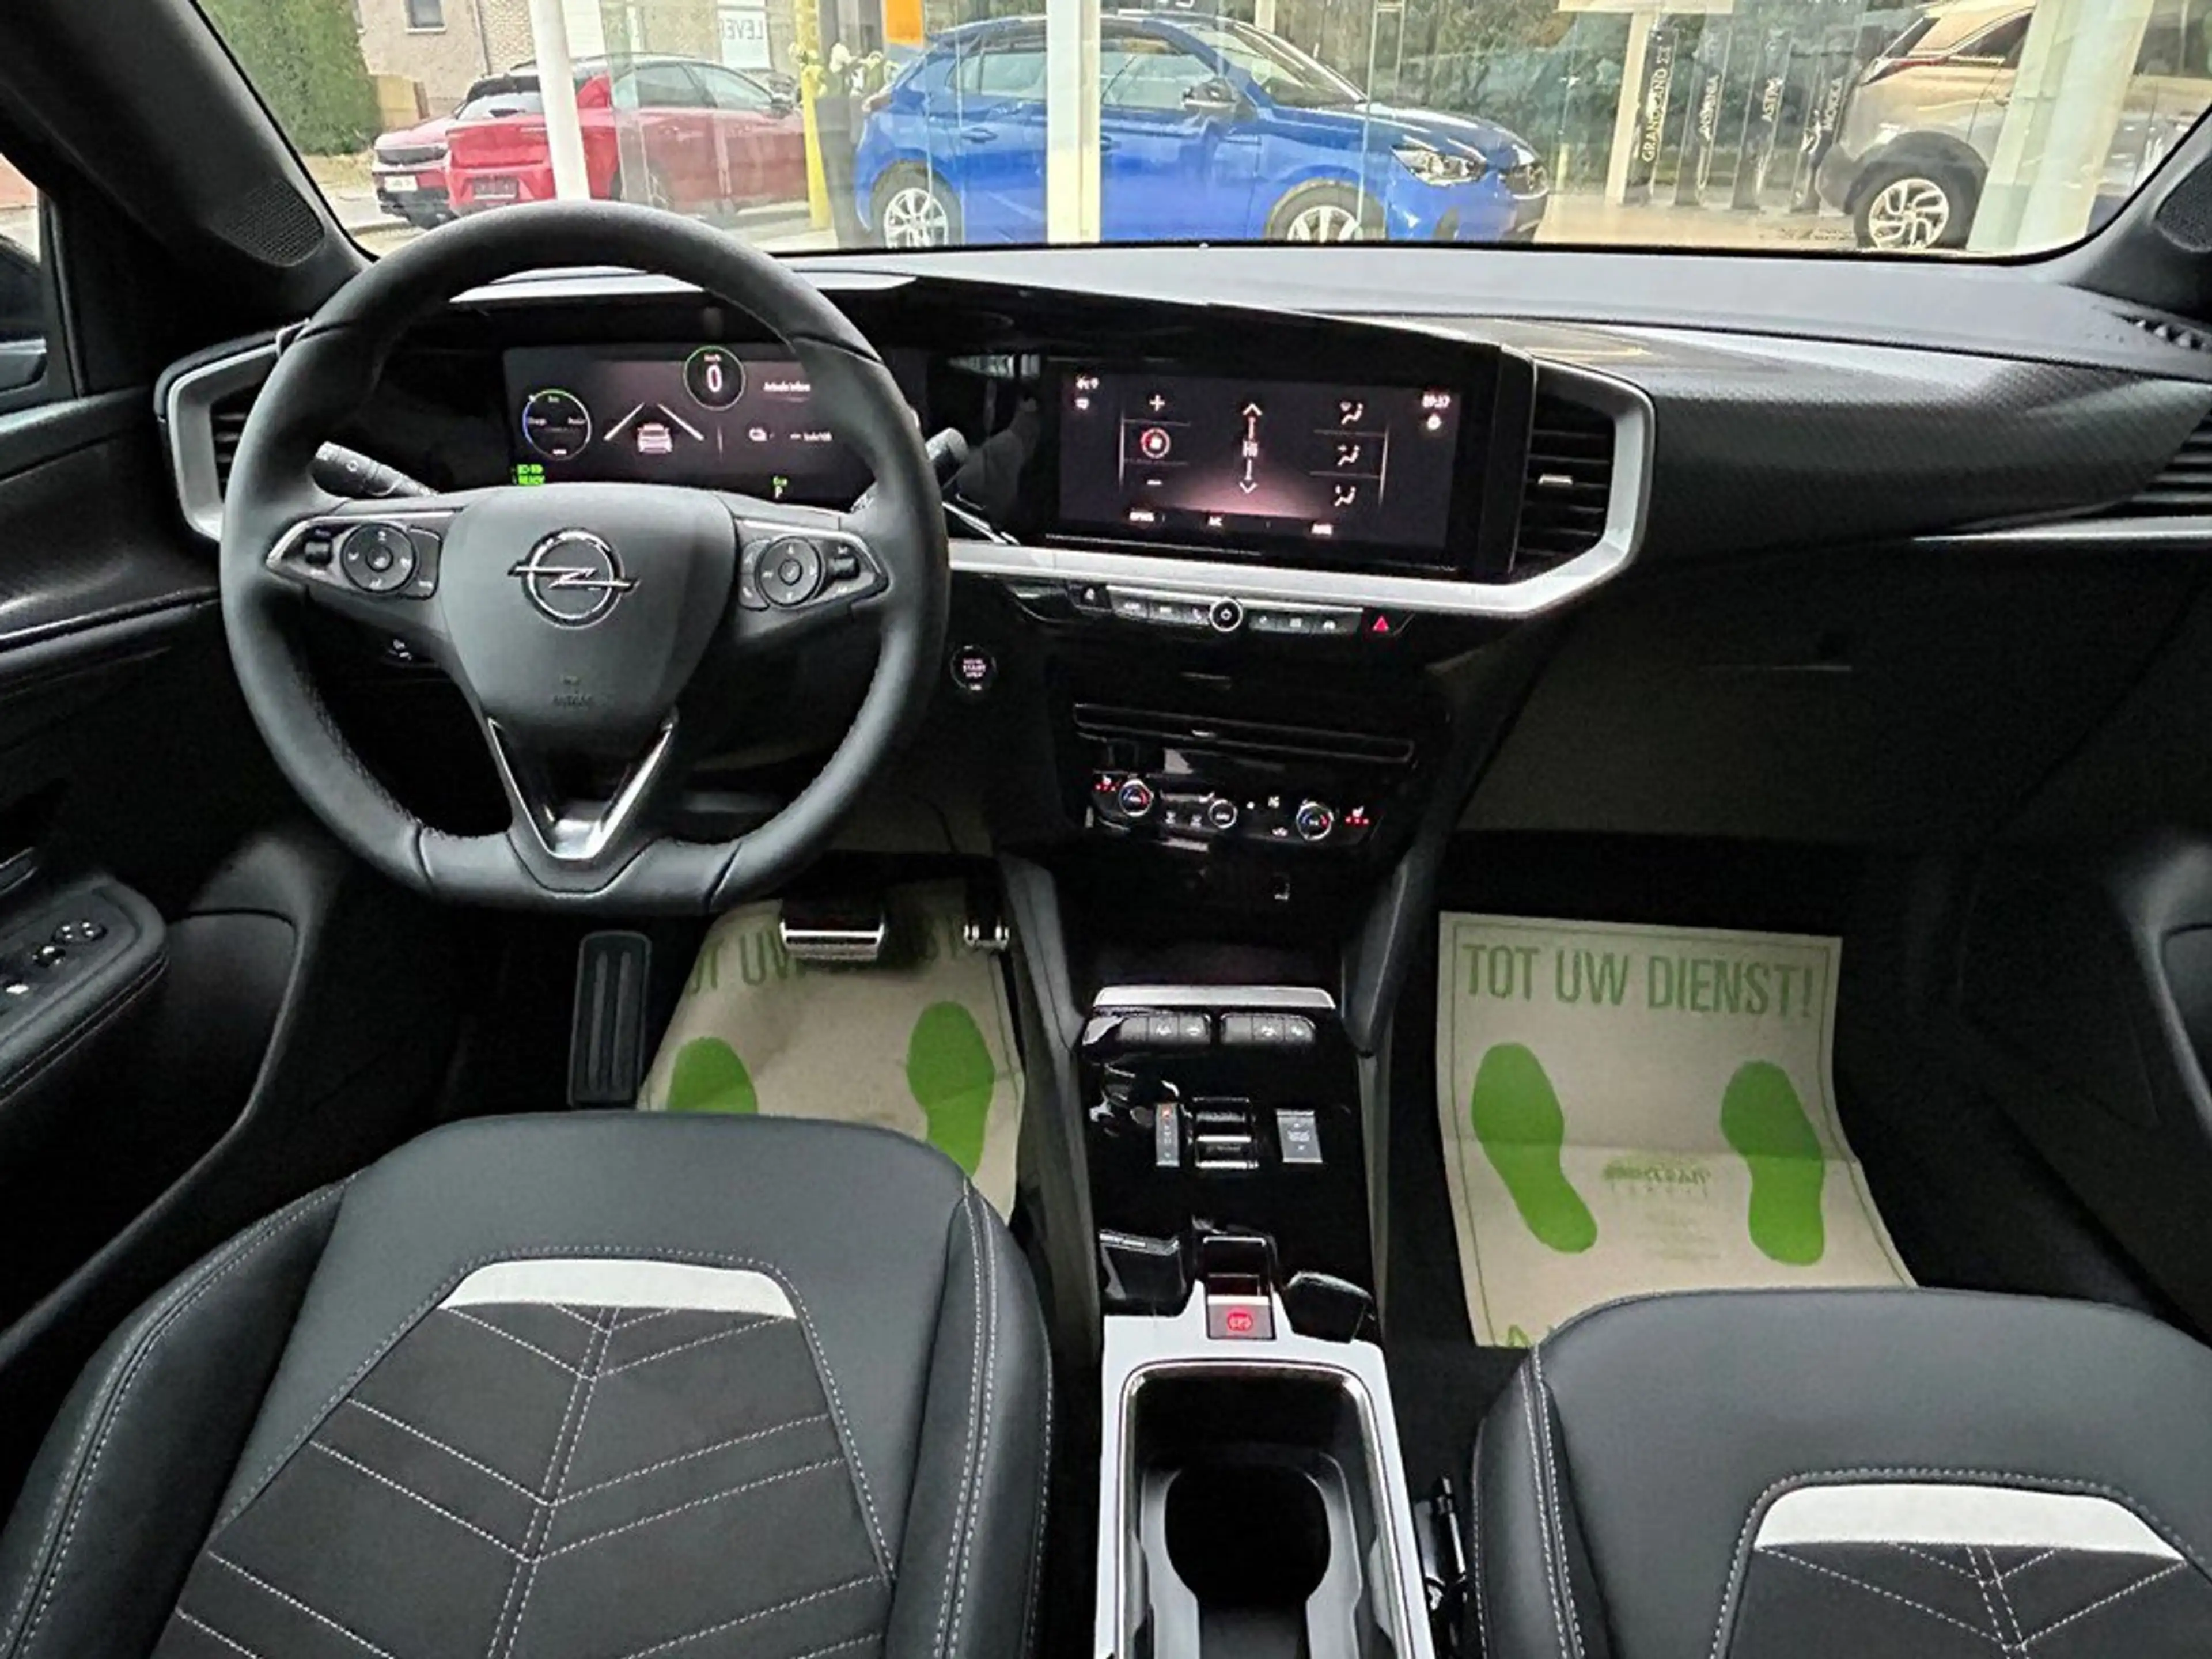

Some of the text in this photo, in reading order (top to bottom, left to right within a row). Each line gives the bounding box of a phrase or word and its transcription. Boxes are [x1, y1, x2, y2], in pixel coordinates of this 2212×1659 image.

[707, 364, 722, 393] 0
[1461, 944, 1814, 1018] TOT UW DIENST!
